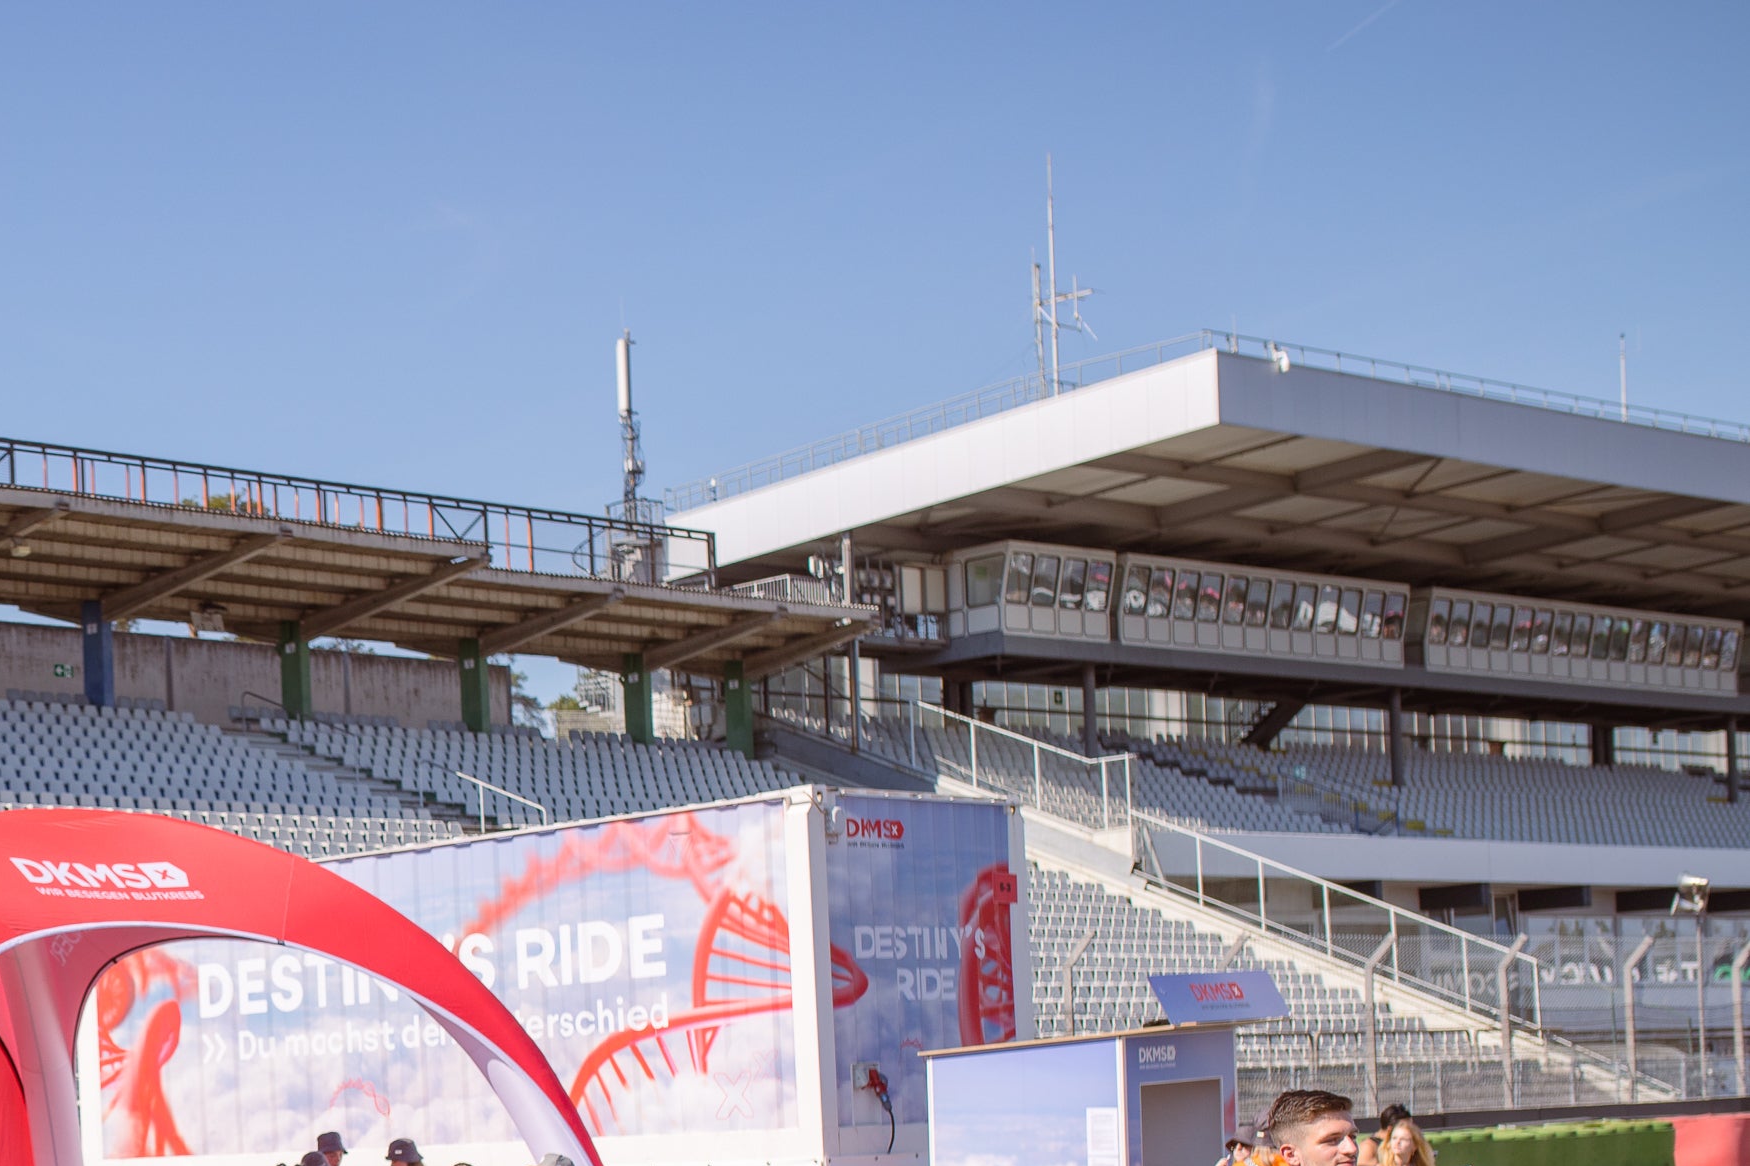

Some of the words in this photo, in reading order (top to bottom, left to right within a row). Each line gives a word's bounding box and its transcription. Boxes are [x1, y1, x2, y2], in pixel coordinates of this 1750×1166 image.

[846, 818, 892, 840] DKMS
[9, 857, 152, 889] DKMS
[35, 886, 65, 897] WIR
[65, 889, 130, 900] BESIEGEN
[131, 889, 205, 901] BLUTKREBS
[854, 925, 986, 960] DESTINY'S
[198, 932, 495, 1018] DESTIN'S
[515, 914, 667, 990] RIDE
[896, 967, 956, 1001] RIDE
[1189, 983, 1232, 1002] DKMS
[238, 1029, 274, 1061] Du
[284, 1018, 396, 1057] machst
[1139, 1046, 1168, 1063] DKMS
